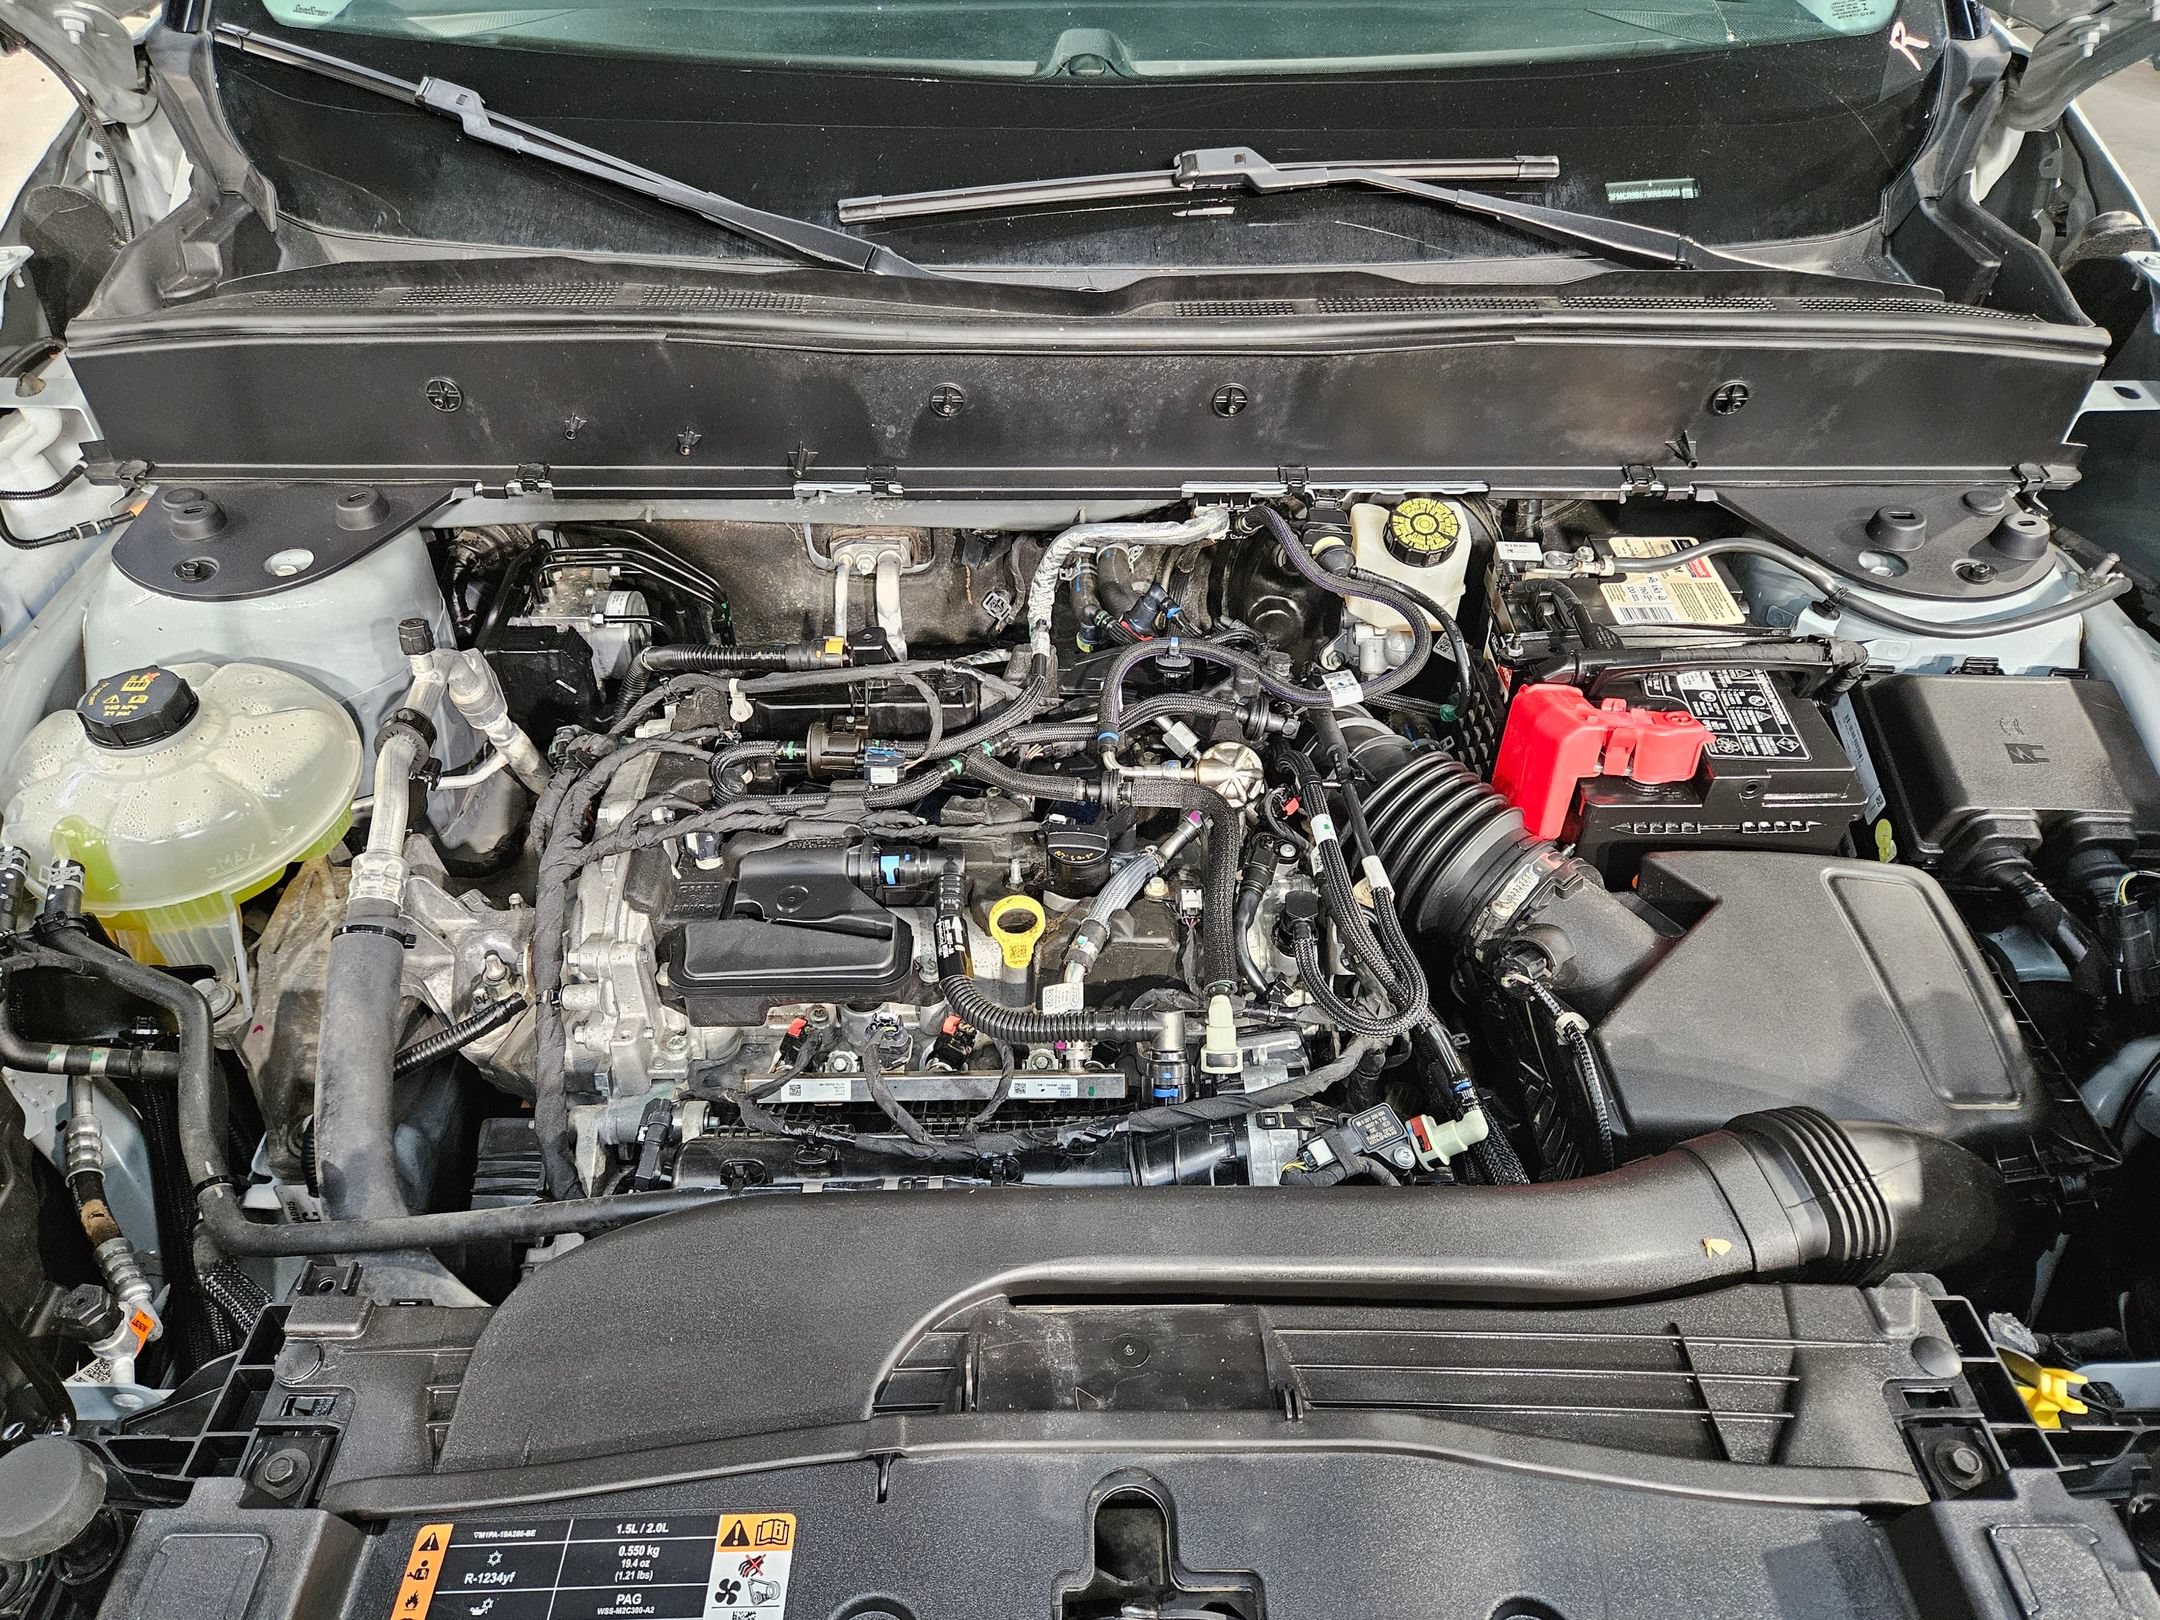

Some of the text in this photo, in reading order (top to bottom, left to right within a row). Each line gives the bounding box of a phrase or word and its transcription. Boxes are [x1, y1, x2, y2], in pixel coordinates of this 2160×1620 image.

[616, 1523, 638, 1534] 1.5L
[646, 1522, 669, 1534] 2.0L
[618, 1544, 661, 1558] 0.550 kg
[621, 1558, 651, 1568] 19.4 oz
[463, 1571, 517, 1586] R-1234yf
[614, 1570, 654, 1583] (1.21 lbs)
[615, 1593, 642, 1605] PAG
